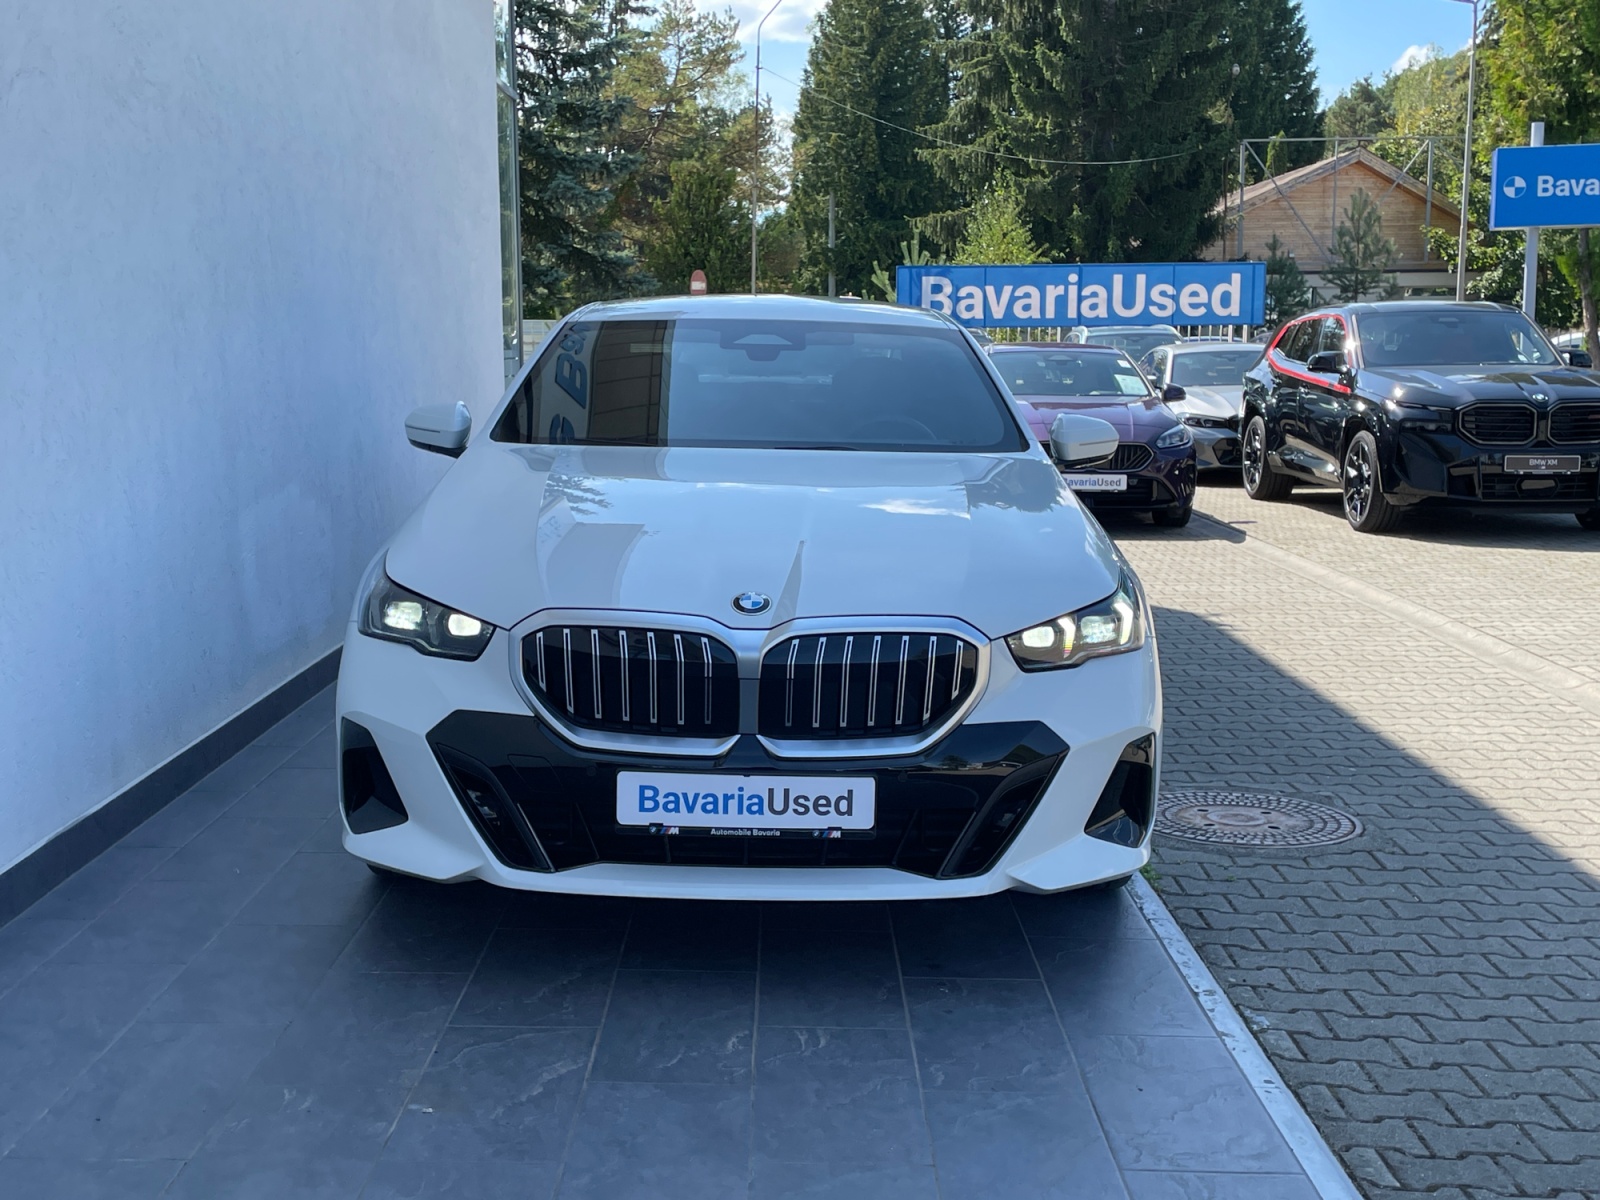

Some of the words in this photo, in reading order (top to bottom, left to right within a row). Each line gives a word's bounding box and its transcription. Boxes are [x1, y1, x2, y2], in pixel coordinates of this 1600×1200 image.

[1537, 175, 1600, 197] Bava
[921, 273, 1242, 319] BavariaUsed
[638, 784, 854, 817] BavariaUsed
[710, 828, 751, 836] Automobile
[752, 829, 780, 837] Bavaria
